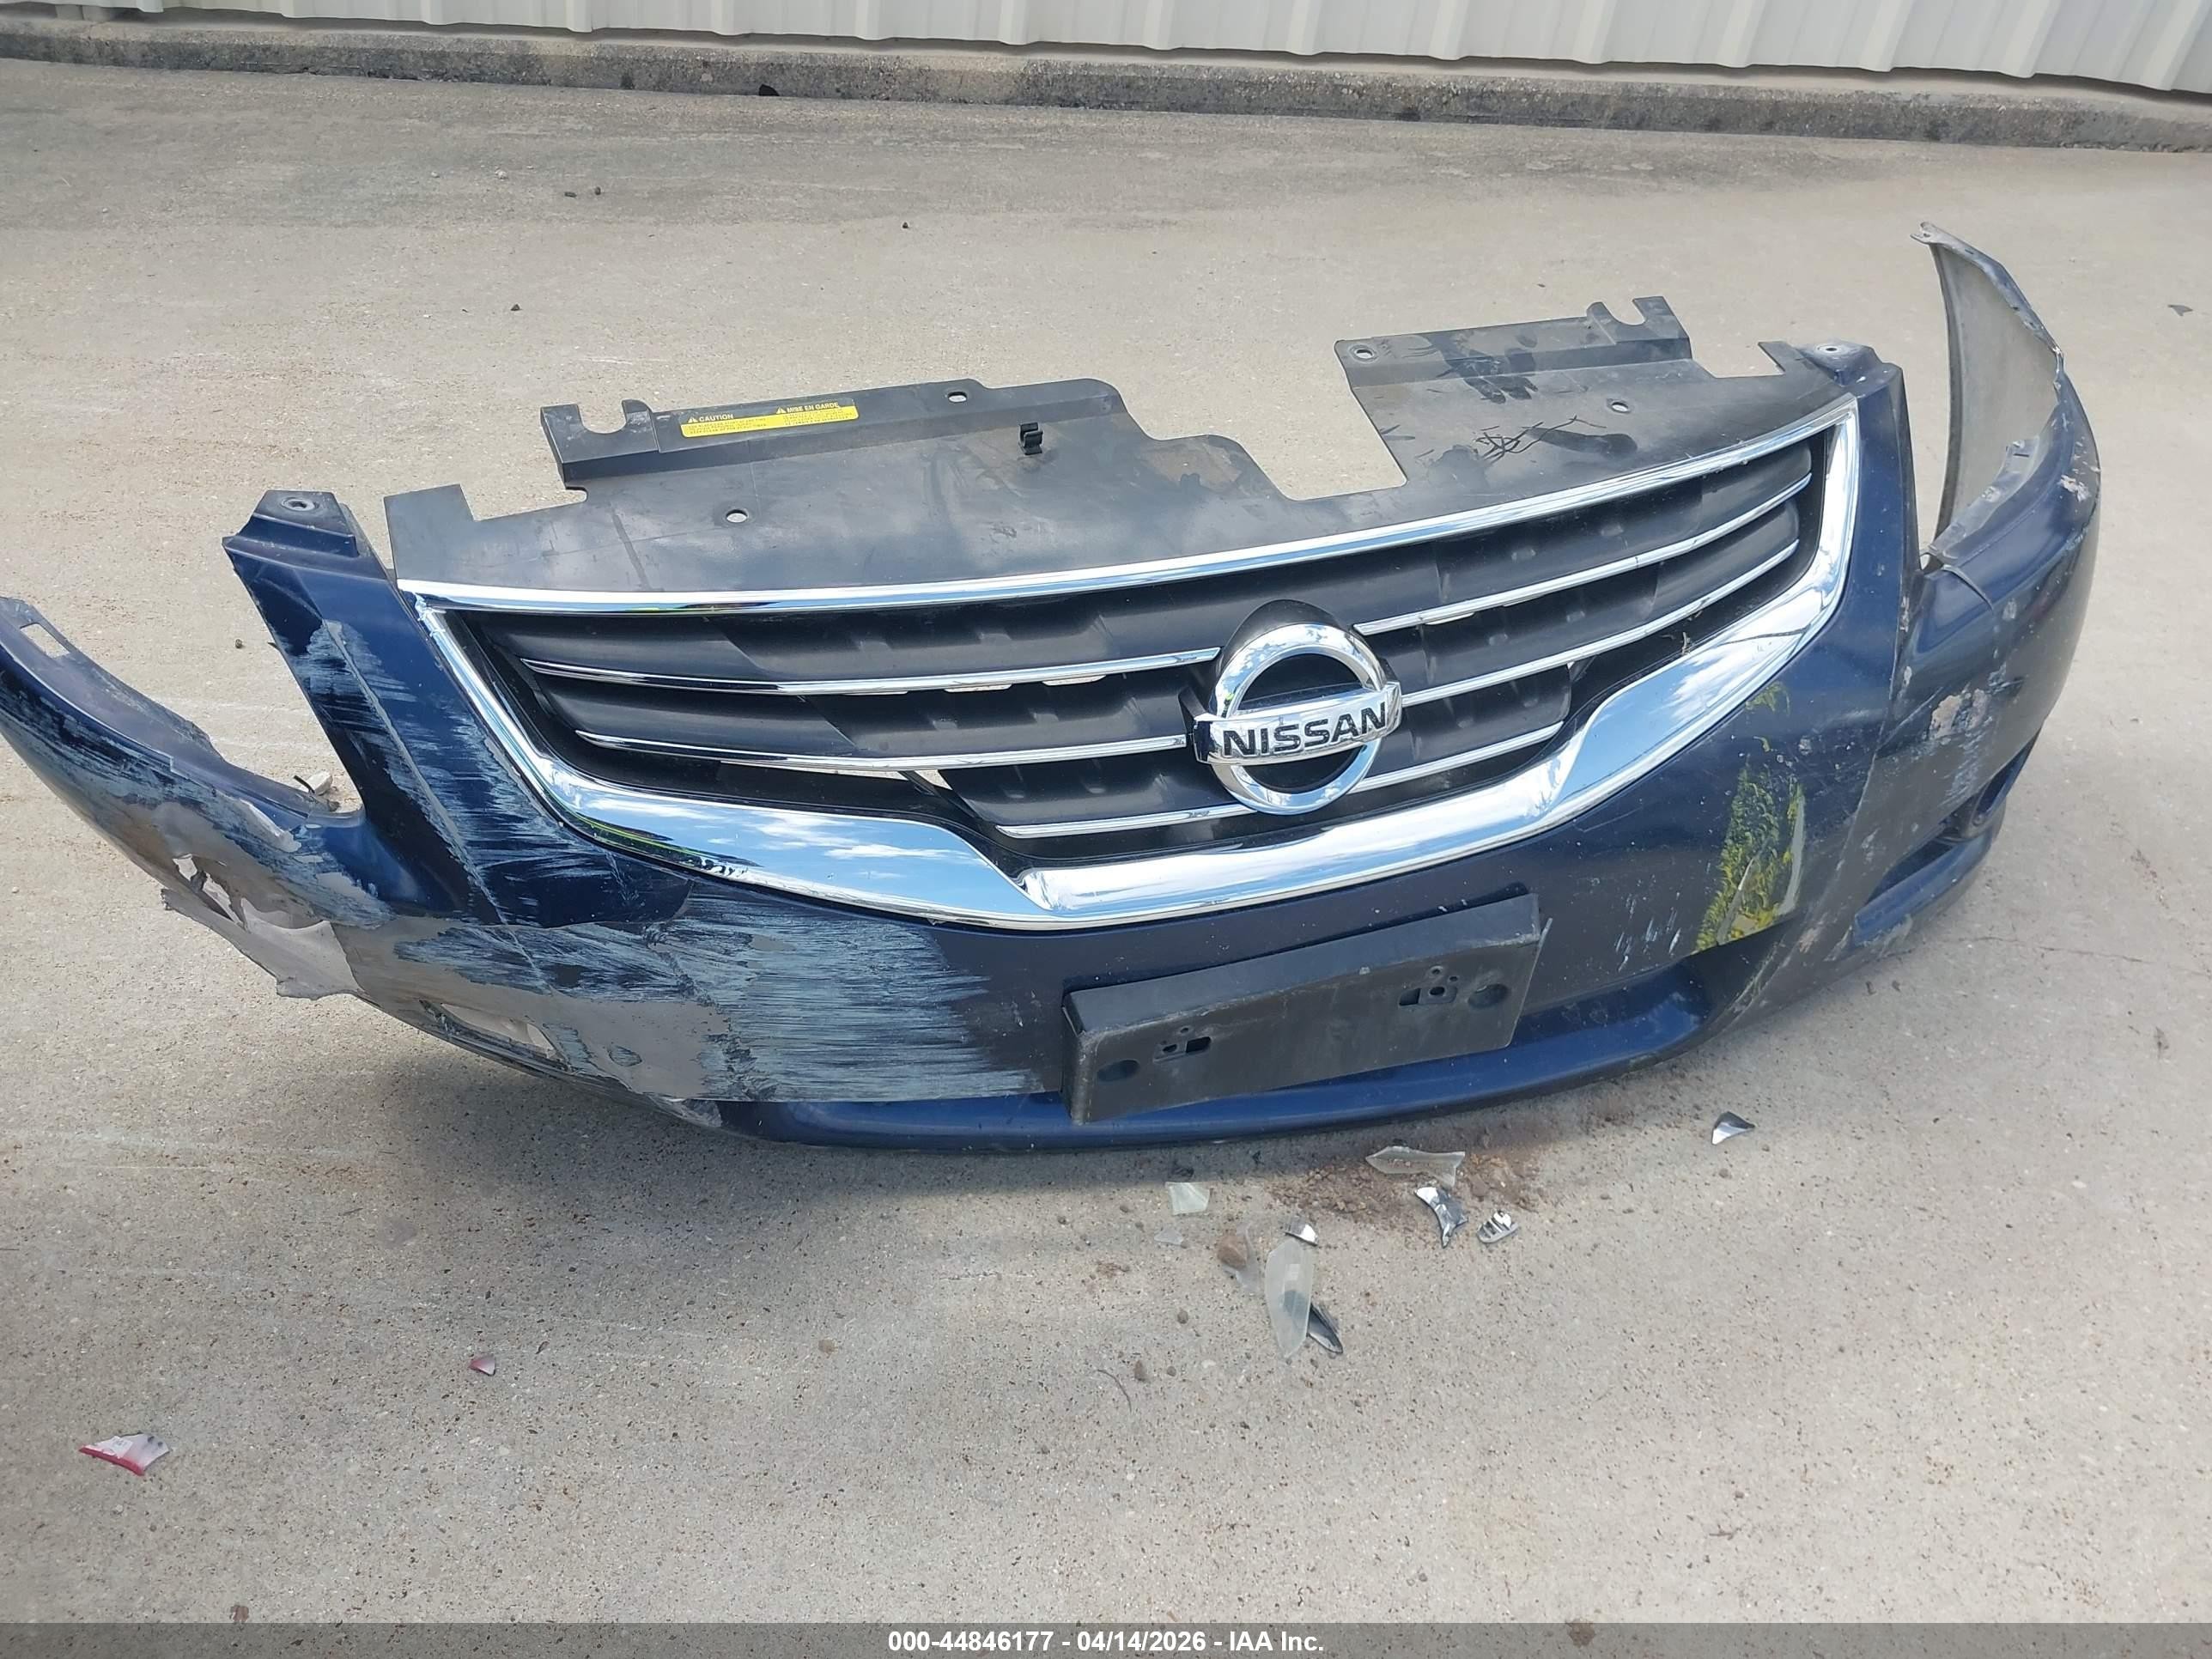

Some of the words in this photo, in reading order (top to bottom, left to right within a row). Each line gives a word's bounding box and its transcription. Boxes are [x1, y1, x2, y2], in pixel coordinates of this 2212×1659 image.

[815, 402, 838, 410] GARDE
[699, 414, 733, 422] CAUTION
[1223, 701, 1387, 757] NISSAN
